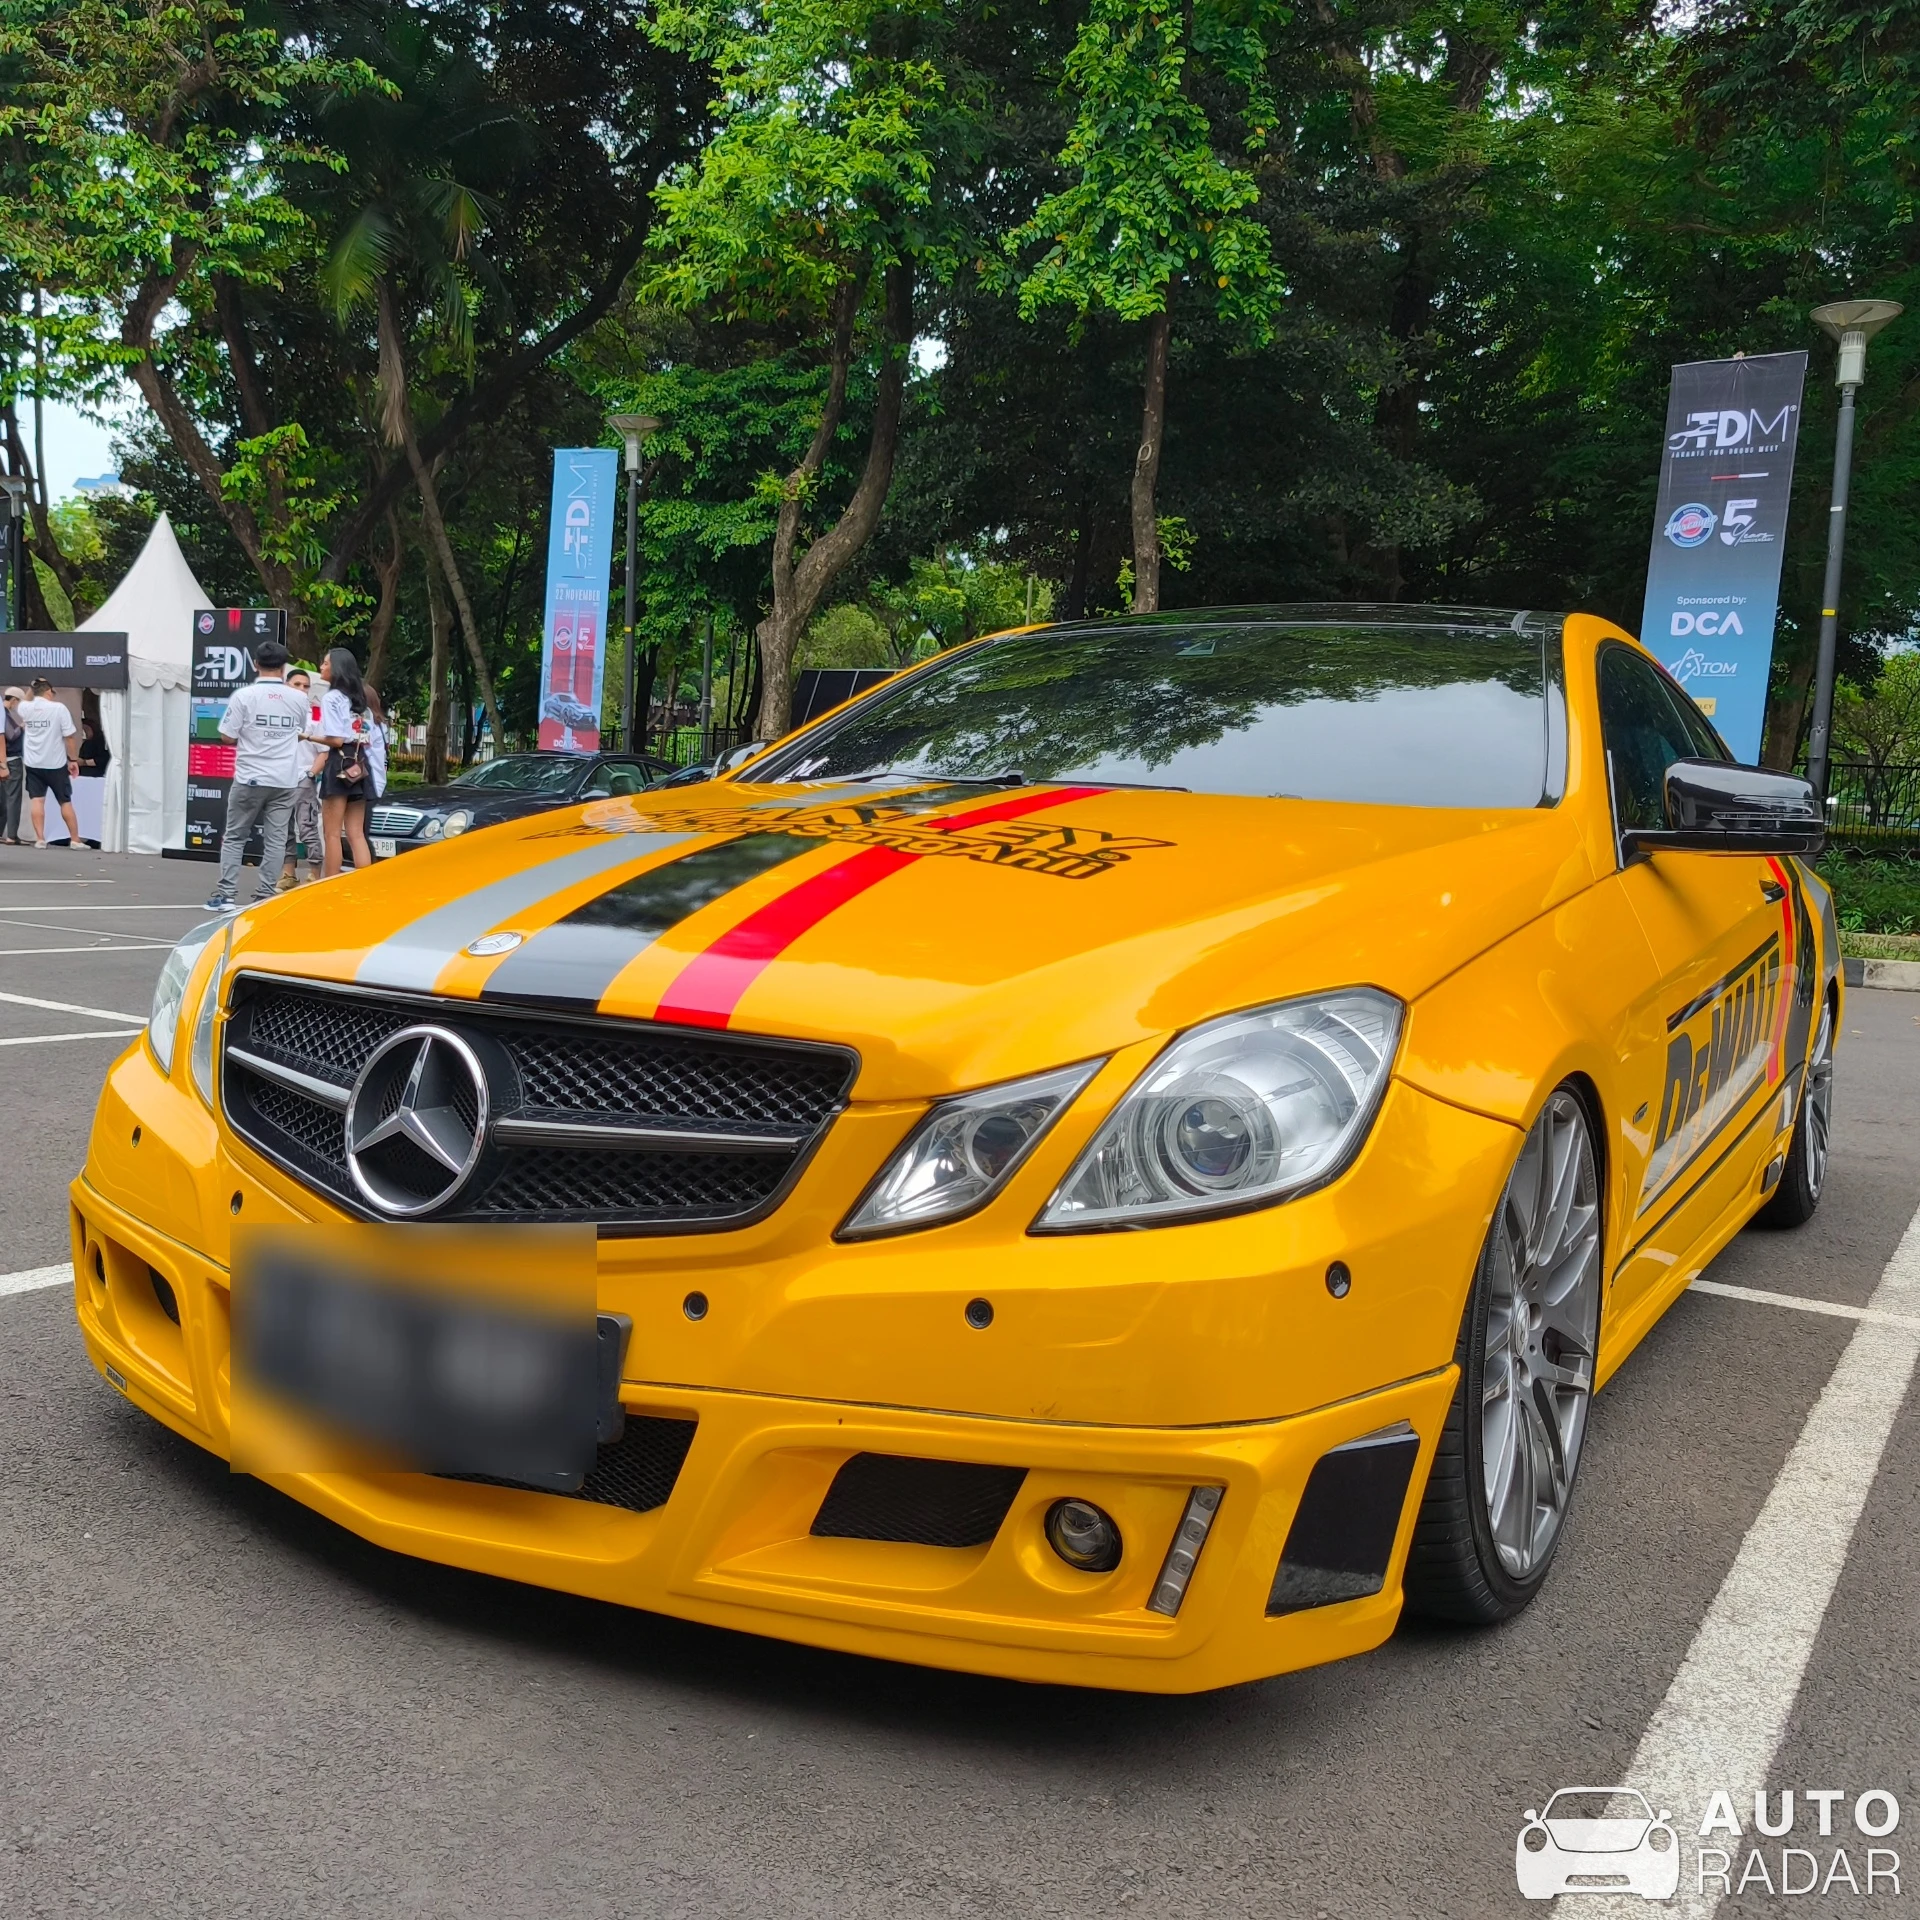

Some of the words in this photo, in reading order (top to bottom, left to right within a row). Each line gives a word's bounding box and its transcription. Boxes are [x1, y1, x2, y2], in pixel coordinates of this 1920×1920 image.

[1677, 596, 1730, 606] Sponsored
[1731, 595, 1747, 606] by:
[1670, 611, 1743, 636] DCA
[10, 646, 74, 668] REGISTRATION
